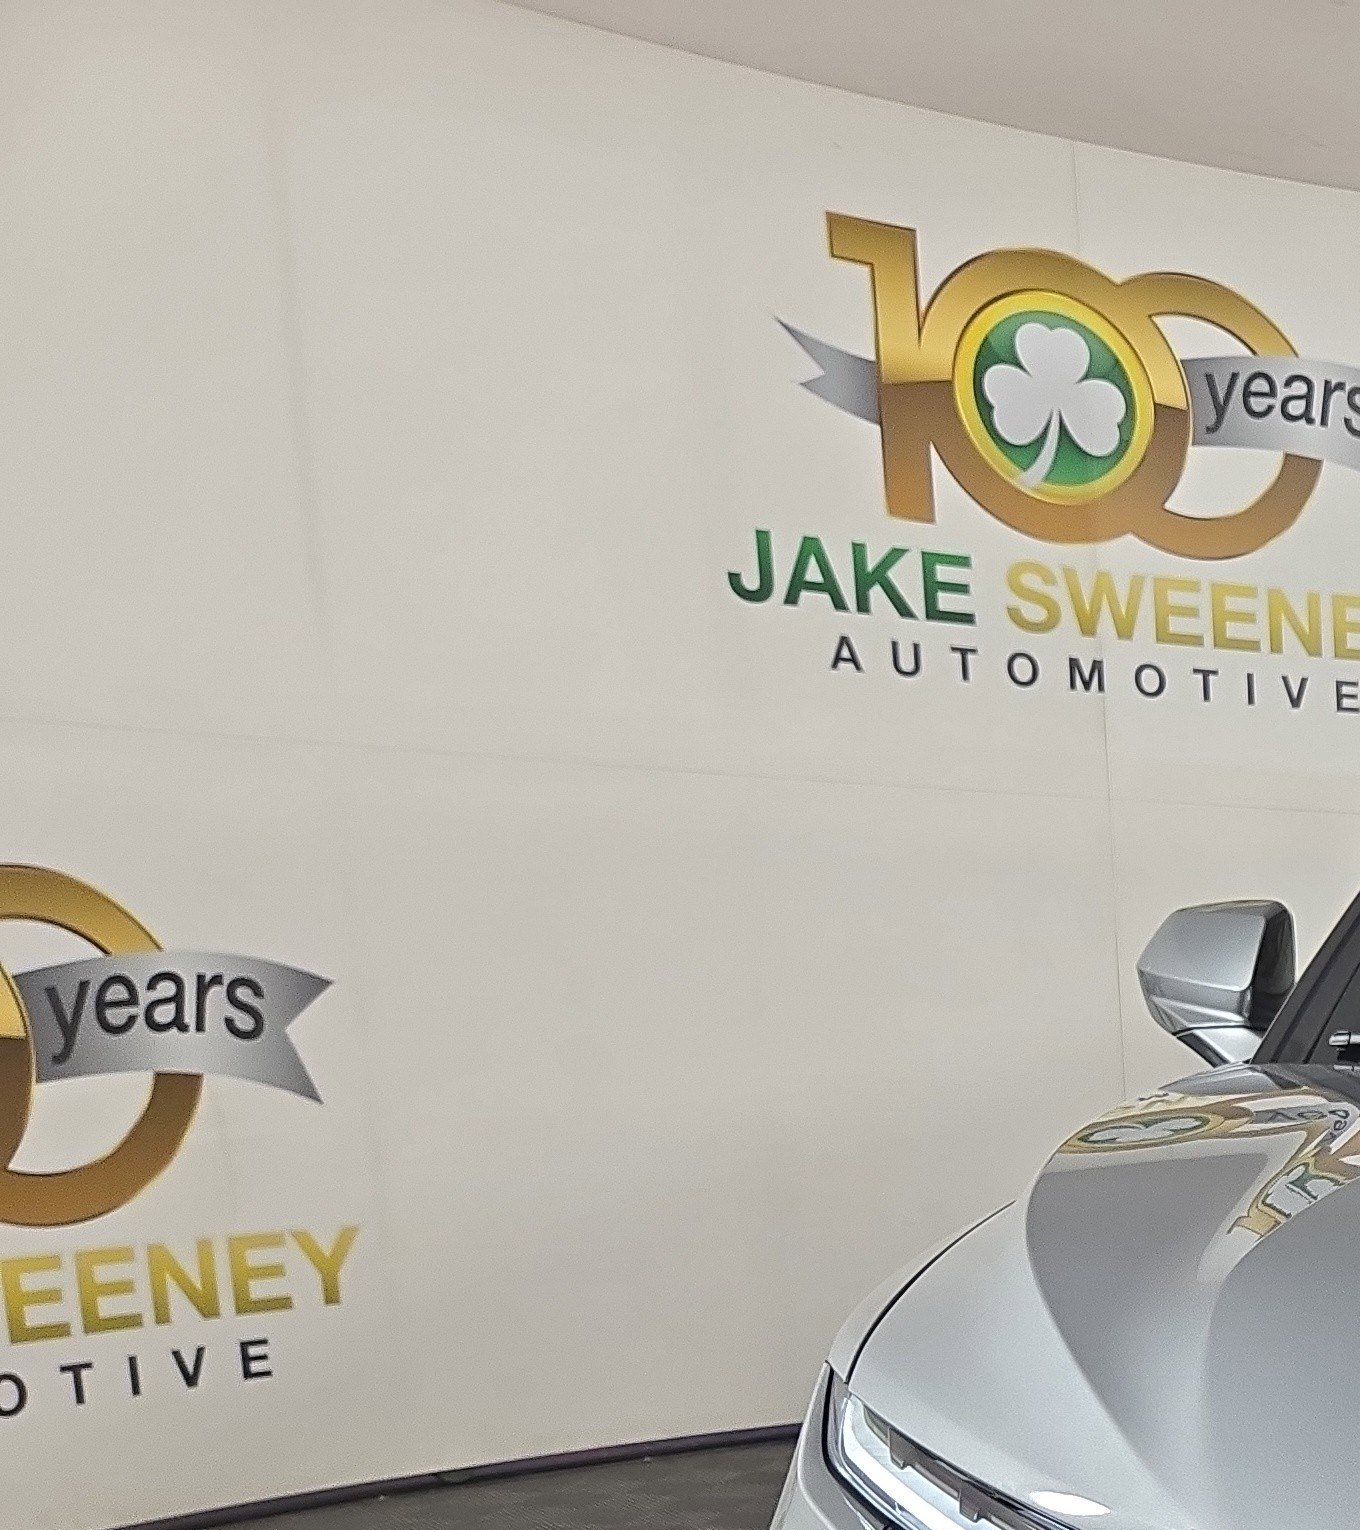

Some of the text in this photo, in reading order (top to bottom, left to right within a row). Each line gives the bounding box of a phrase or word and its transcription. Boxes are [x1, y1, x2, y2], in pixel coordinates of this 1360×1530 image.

[825, 210, 1323, 561] 100
[727, 528, 977, 625] JAKE
[44, 970, 267, 1066] years
